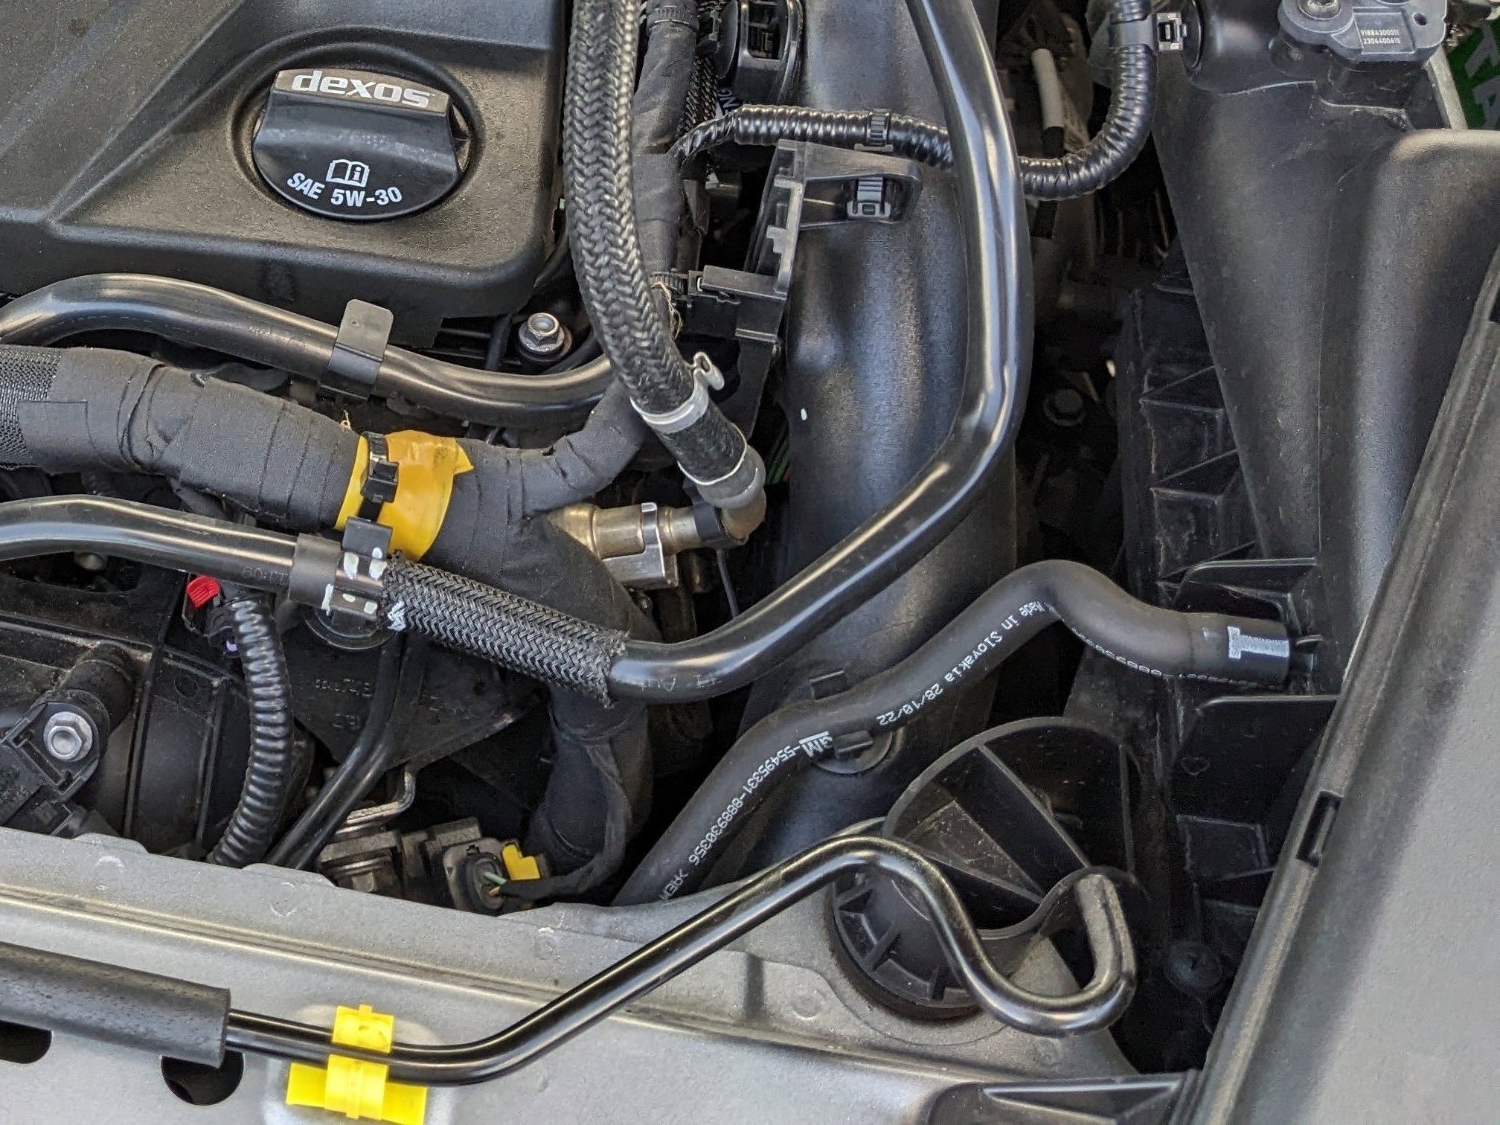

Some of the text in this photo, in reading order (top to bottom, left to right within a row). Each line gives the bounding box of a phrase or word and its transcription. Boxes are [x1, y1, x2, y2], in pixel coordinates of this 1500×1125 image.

[291, 70, 430, 108] dexos
[287, 172, 402, 207] SAE 5W-30
[1000, 614, 1018, 631] in
[944, 629, 1004, 683] Slovakia
[875, 682, 944, 726] 28/10/22
